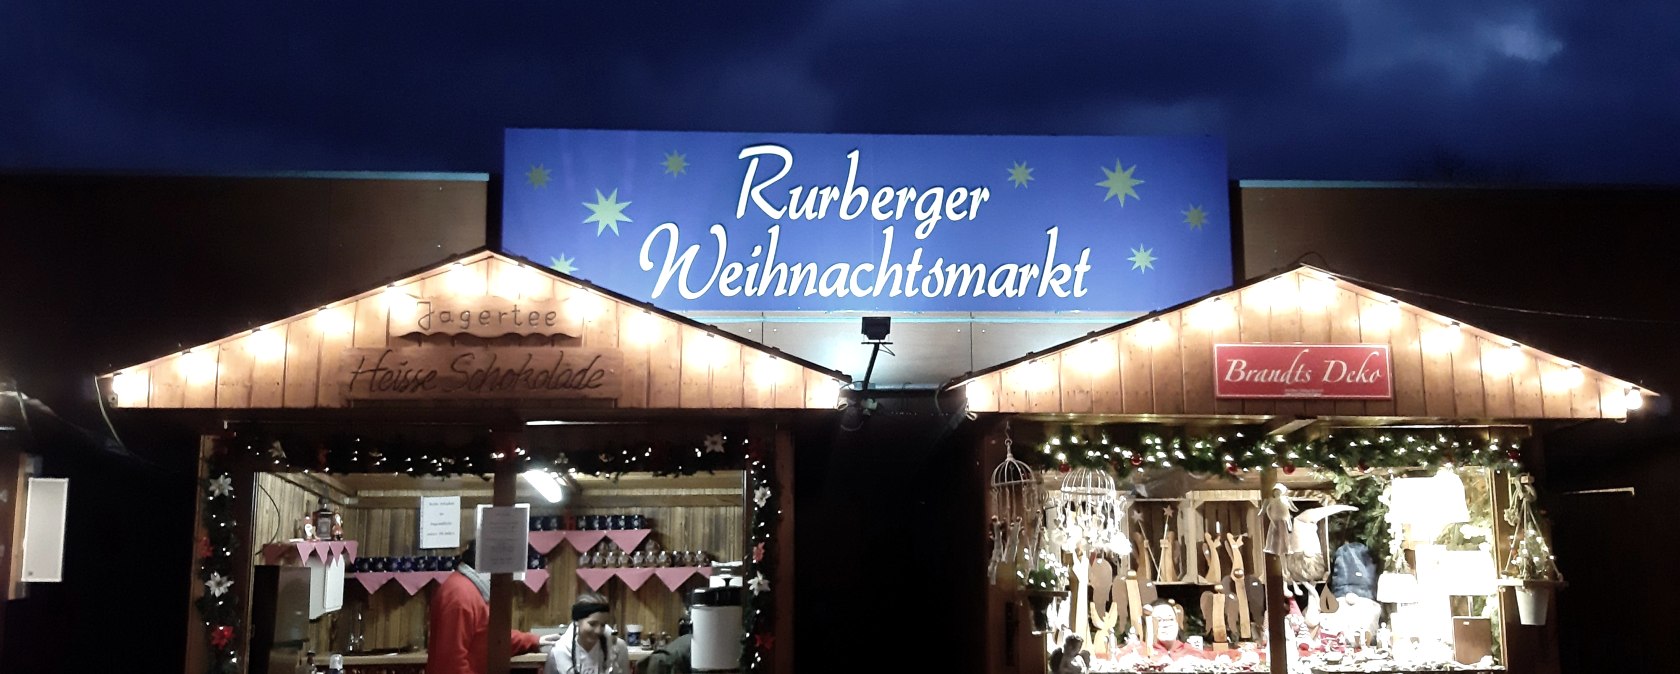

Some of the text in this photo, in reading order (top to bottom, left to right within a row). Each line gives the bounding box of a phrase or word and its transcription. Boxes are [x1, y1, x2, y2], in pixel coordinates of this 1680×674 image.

[736, 144, 991, 240] Rurberger
[638, 222, 1091, 300] Weihnachtsmarkt
[349, 349, 606, 394] Heisse Schokolade
[1224, 348, 1383, 385] Brandts Deko
